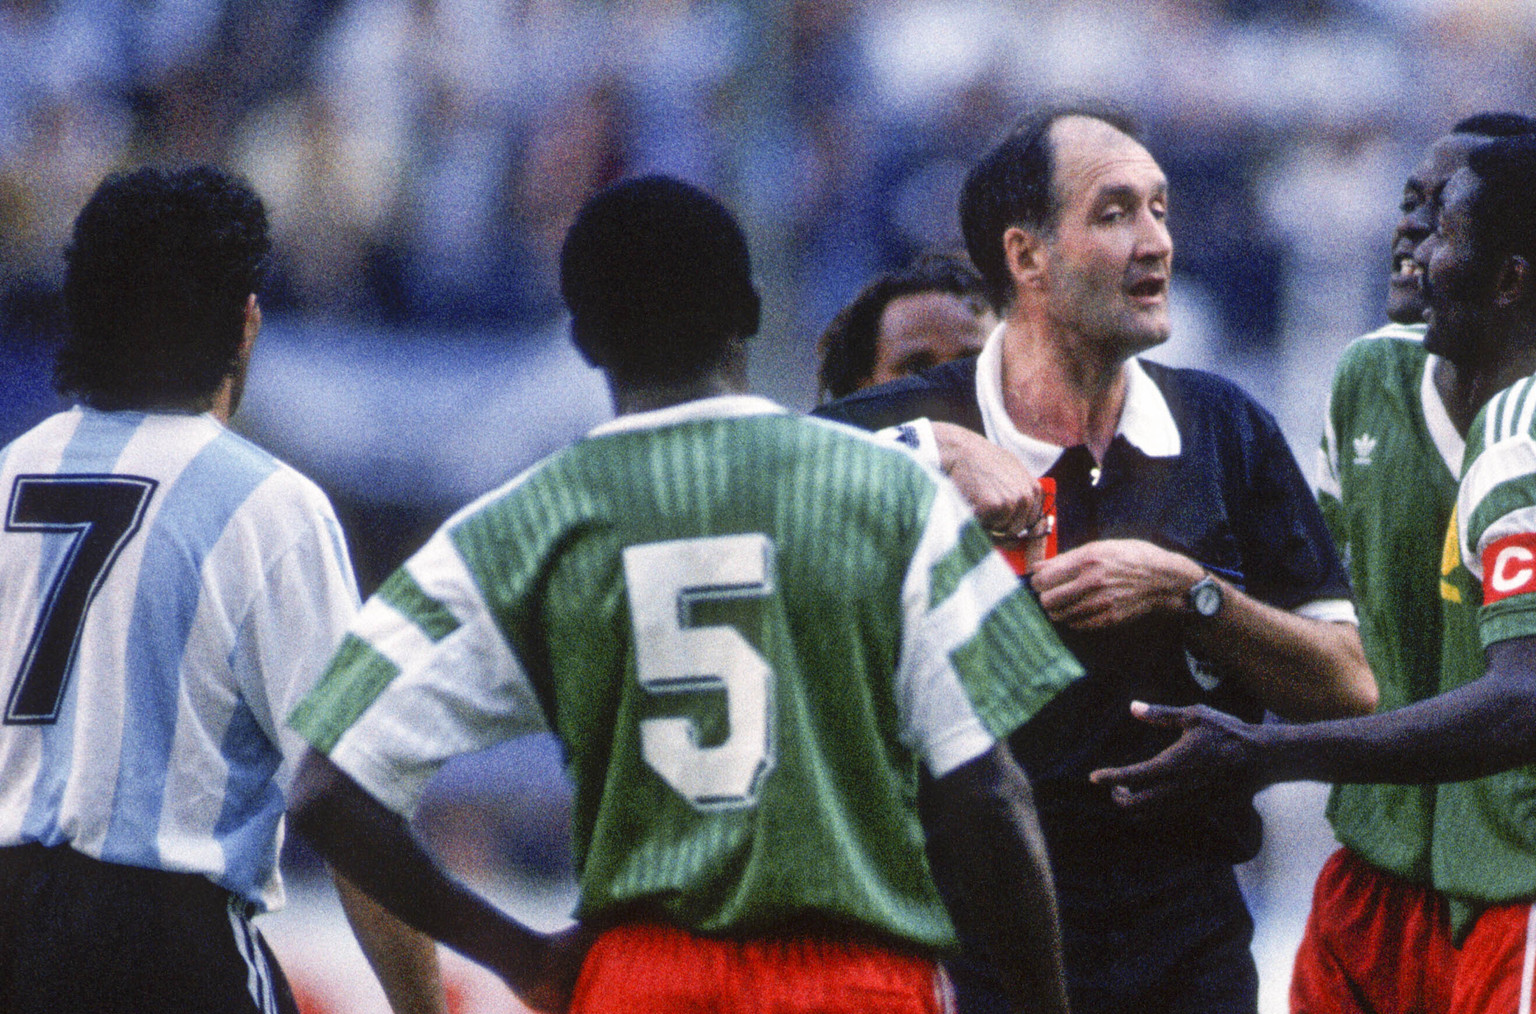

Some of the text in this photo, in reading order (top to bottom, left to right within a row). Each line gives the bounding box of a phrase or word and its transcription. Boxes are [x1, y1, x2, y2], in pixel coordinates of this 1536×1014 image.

[2, 474, 158, 726] 7
[622, 532, 778, 812] 5
[1491, 546, 1534, 592] C
